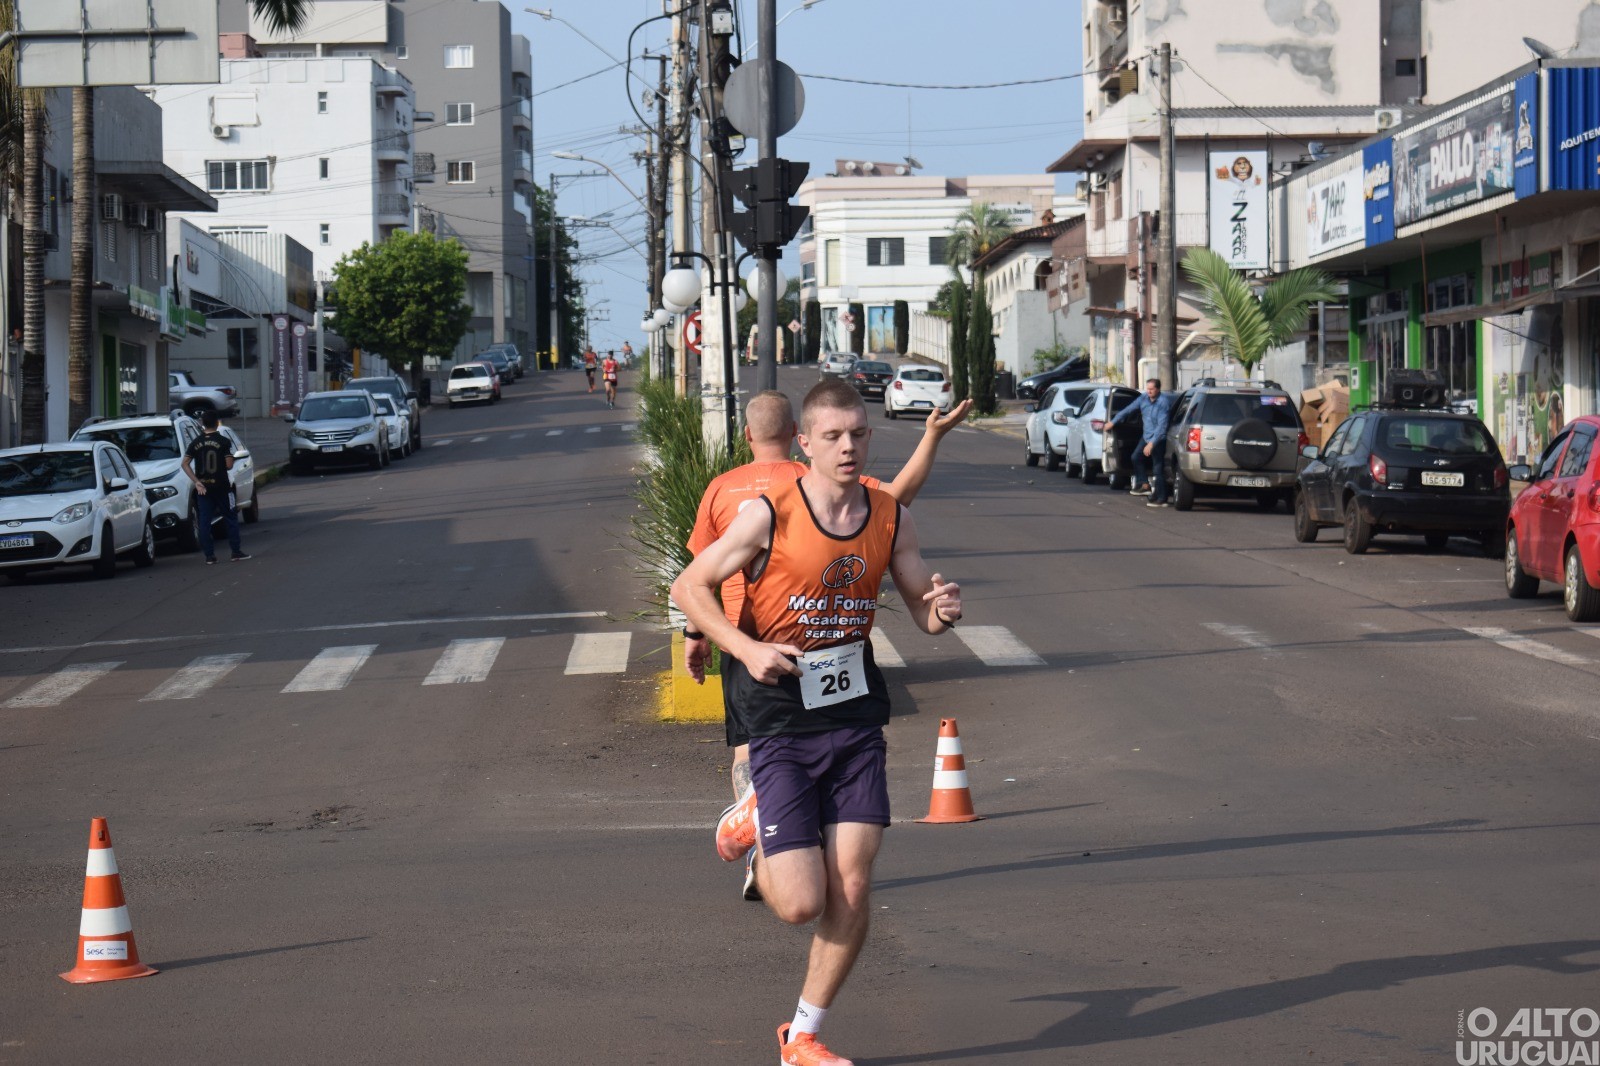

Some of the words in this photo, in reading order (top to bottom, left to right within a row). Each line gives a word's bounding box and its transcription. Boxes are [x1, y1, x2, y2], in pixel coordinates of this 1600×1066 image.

[1560, 134, 1583, 151] AQUI
[1430, 131, 1474, 189] PAULO
[788, 594, 828, 611] Med
[797, 613, 869, 626] Academia
[805, 630, 845, 639] SEBERI
[820, 669, 851, 696] 26
